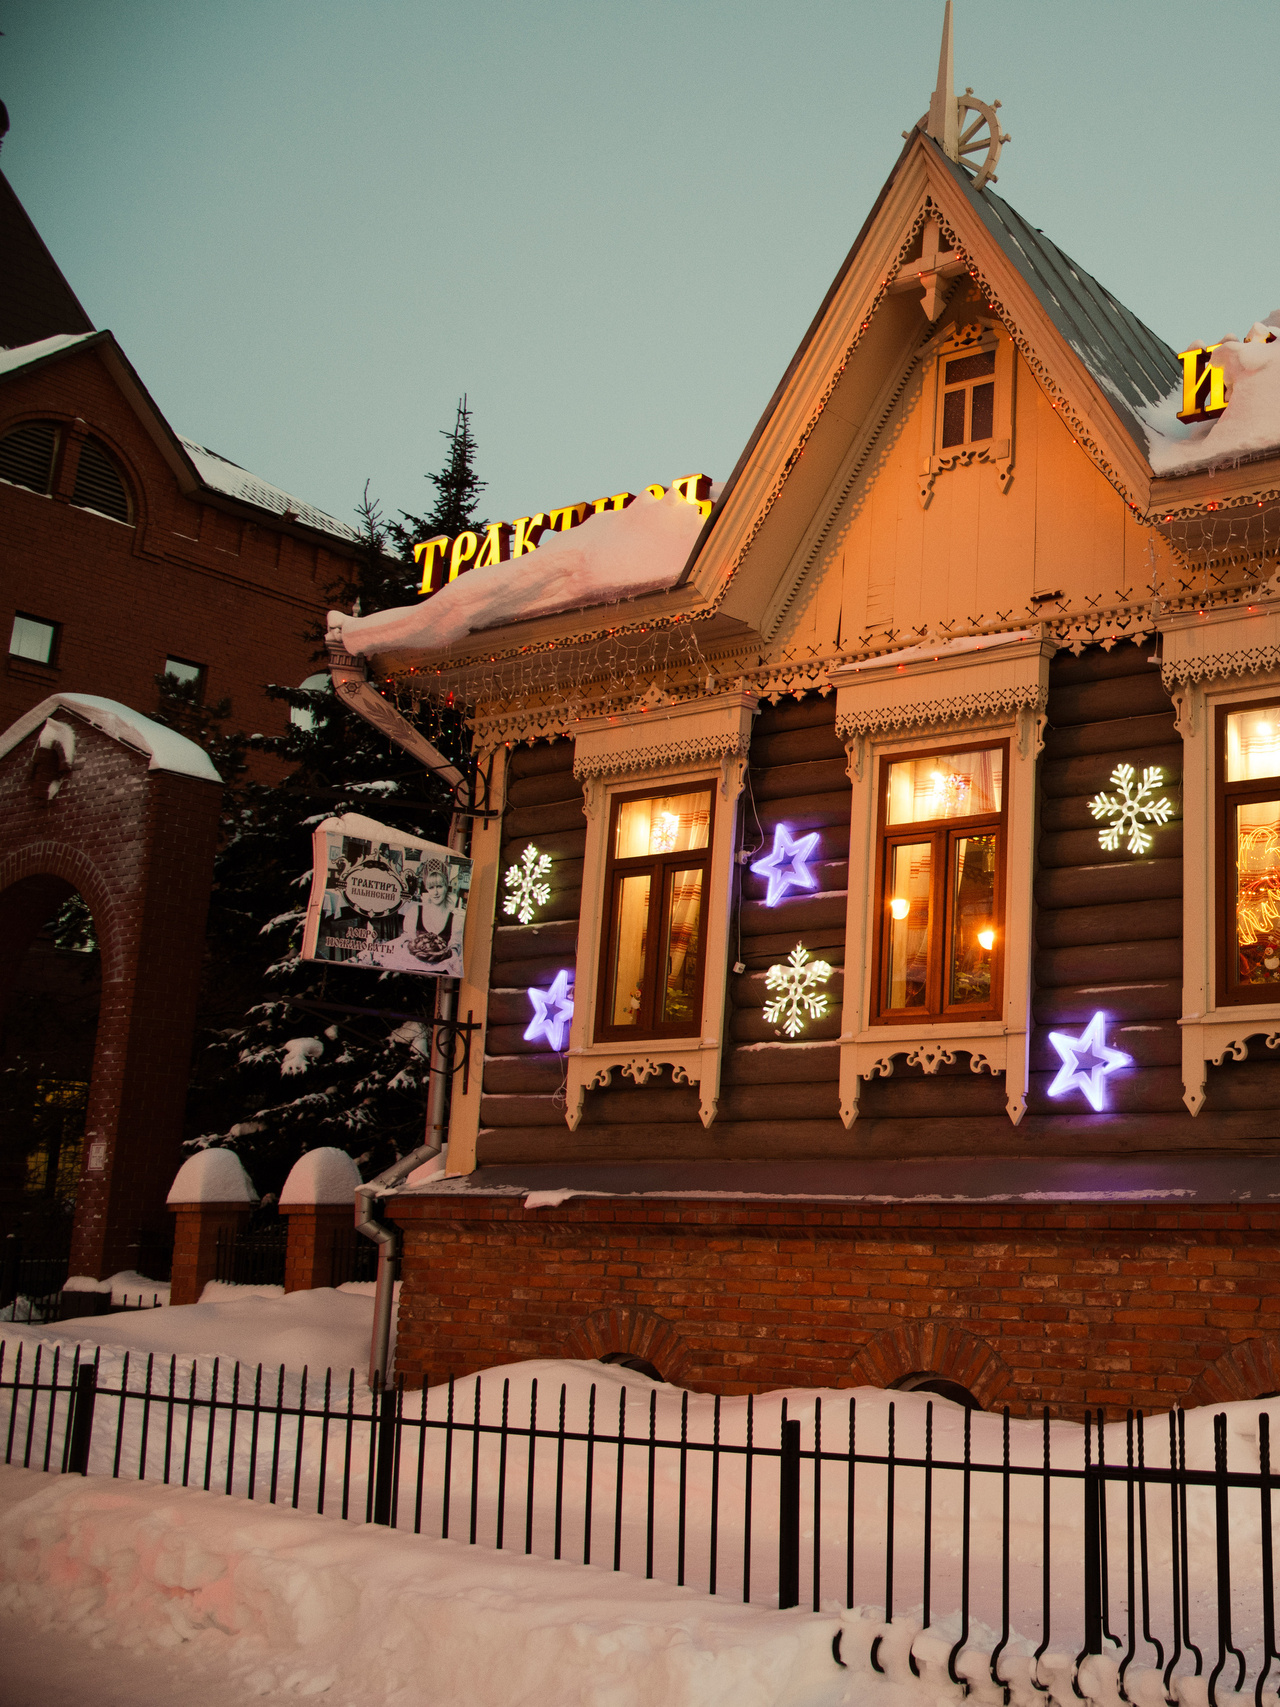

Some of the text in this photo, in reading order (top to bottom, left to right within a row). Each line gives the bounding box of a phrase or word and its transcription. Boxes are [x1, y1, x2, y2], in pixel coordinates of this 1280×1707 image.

[351, 877, 398, 892] ТРАКТИРЪ
[351, 887, 396, 901] ИЛЬИНСКИЙ
[345, 926, 379, 940] ДОБРО
[325, 936, 395, 954] ПОЖАЛОВАТЬ!
